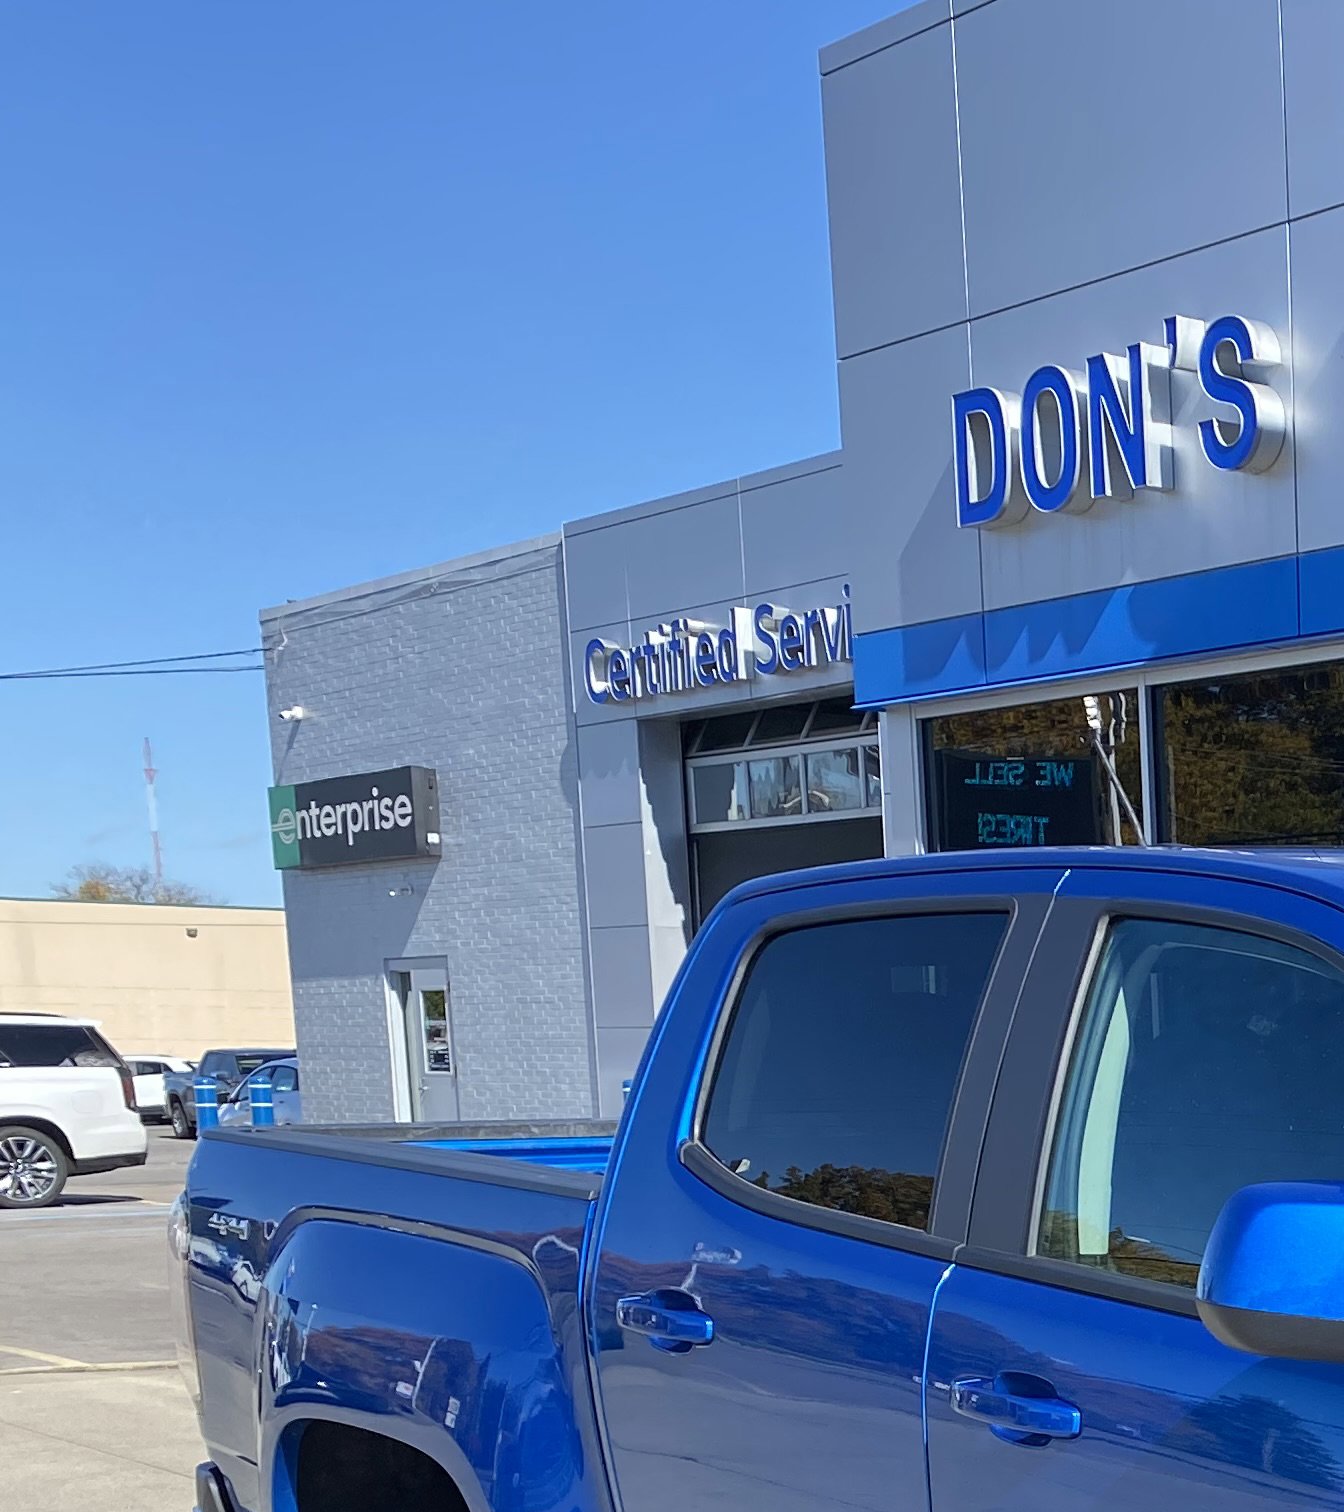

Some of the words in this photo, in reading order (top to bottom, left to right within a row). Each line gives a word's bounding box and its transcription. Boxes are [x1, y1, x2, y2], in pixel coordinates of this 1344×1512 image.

[951, 314, 1282, 528] DON'S
[584, 607, 741, 704] Certified
[754, 585, 852, 675] Servi
[271, 786, 413, 846] enterprise
